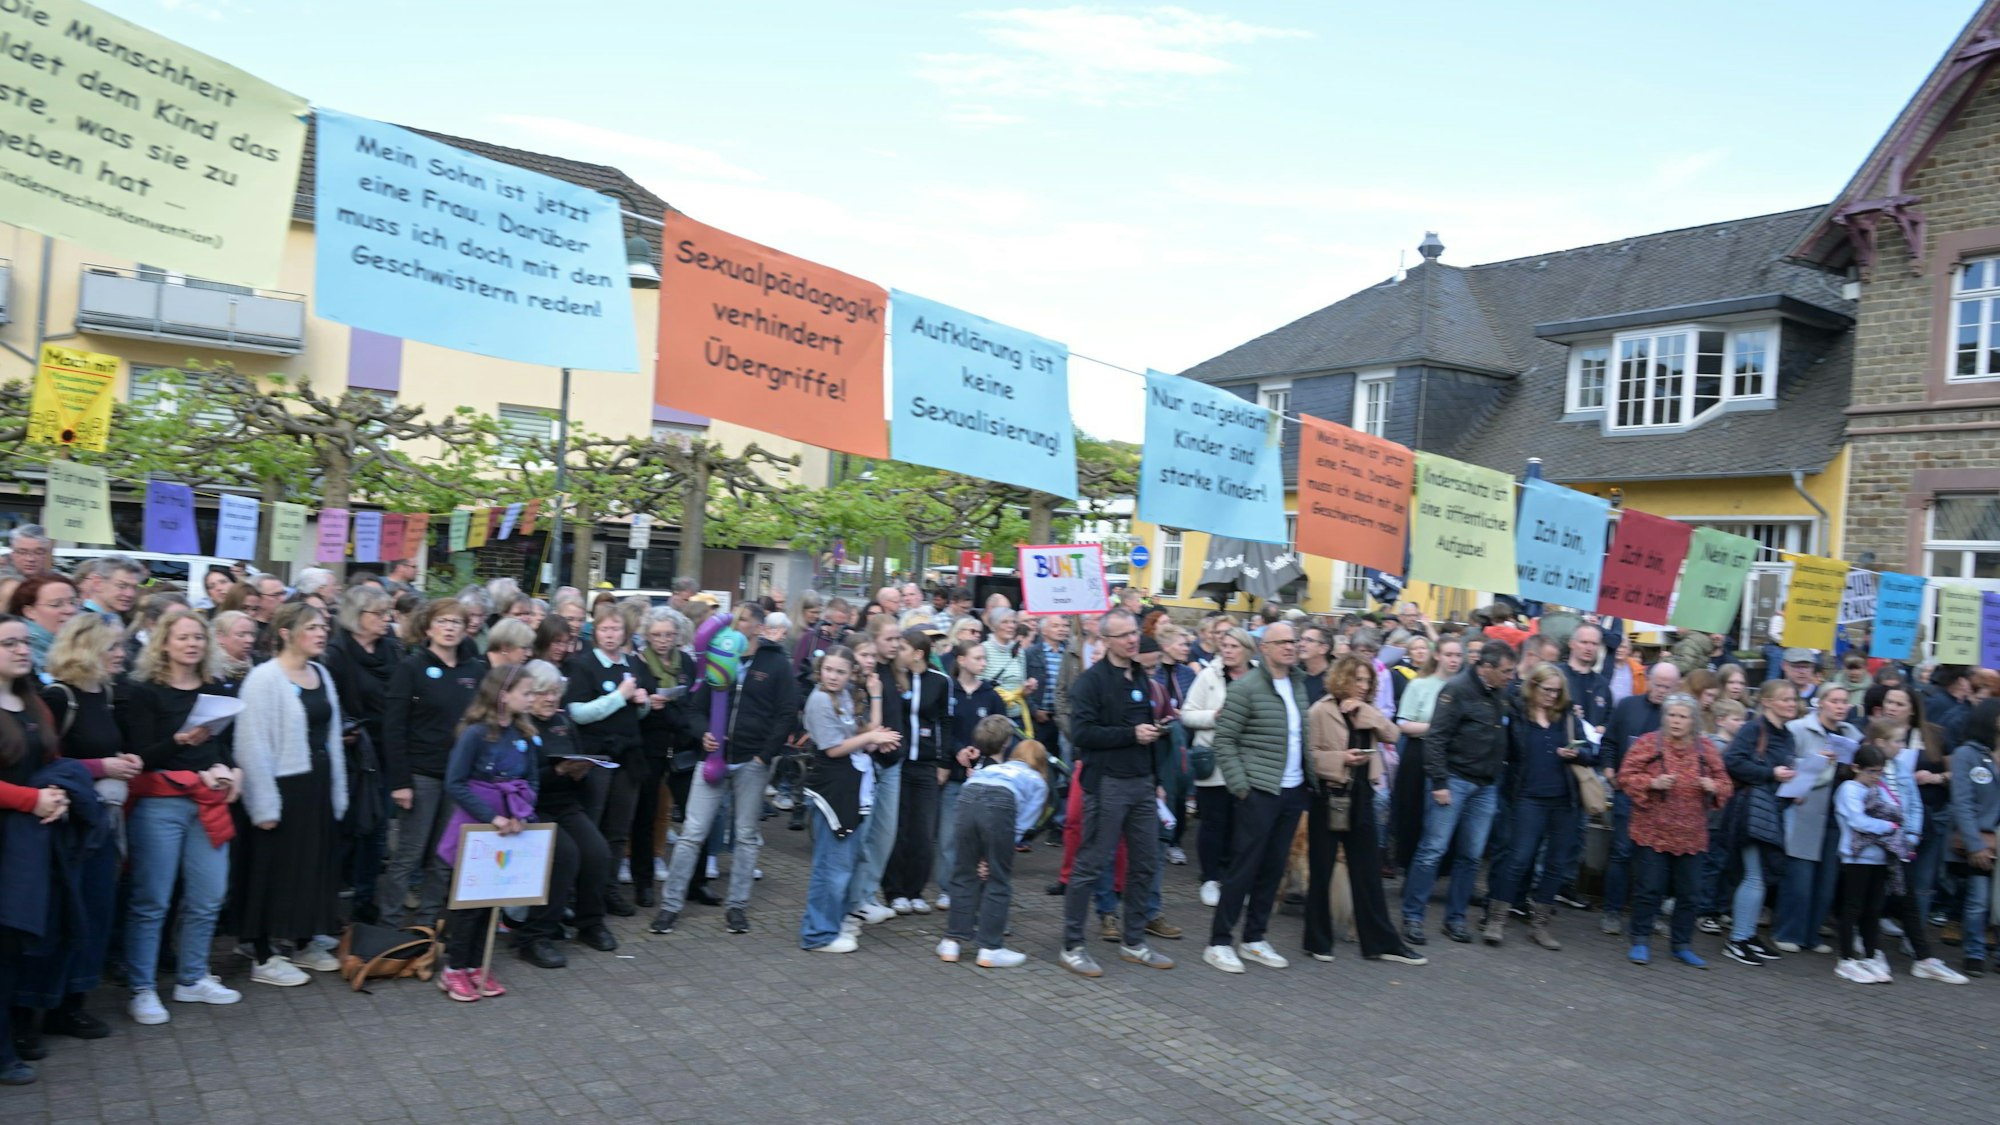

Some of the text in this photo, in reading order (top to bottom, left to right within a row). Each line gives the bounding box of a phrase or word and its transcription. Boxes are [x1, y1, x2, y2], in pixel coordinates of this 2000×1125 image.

[63, 18, 238, 107] Menschheit
[77, 69, 142, 112] dem
[152, 97, 220, 142] Kind
[228, 132, 281, 163] das
[75, 114, 135, 150] was
[146, 143, 190, 171] sie
[203, 163, 238, 187] zu
[97, 160, 153, 197] hat
[356, 134, 591, 224] Mein Sohn ist jetzt
[0, 164, 224, 250] inderrechtskonvention)
[358, 175, 591, 254] eine Frau. Darüber
[336, 206, 613, 289] muss ich doch mit den
[351, 244, 603, 319] Geschwistern reden!
[675, 238, 879, 324] Sexualpädagogik
[712, 300, 844, 356] verhindert
[911, 314, 1054, 375] Aufklärung ist
[704, 336, 847, 402] Übergriffe!
[962, 365, 1016, 401] keine
[1151, 386, 1184, 412] Nur
[910, 396, 1062, 457] Sexualisierung!
[1315, 431, 1340, 447] Mein
[1343, 438, 1366, 454] Sohn
[1173, 428, 1256, 466] Kinder sind
[1316, 457, 1338, 471] eine
[1159, 466, 1270, 503] starke Kinder!
[1307, 479, 1333, 494] muss
[1336, 484, 1350, 498] ich
[1353, 489, 1375, 505] doch
[1492, 484, 1509, 502] ist
[1311, 500, 1376, 528] Geschwistern
[1420, 499, 1508, 532] eine öffentliche
[1435, 534, 1487, 560] Aufgabe!
[1533, 518, 1587, 556] Ich bin,
[1618, 544, 1643, 567] Ich
[1031, 553, 1085, 580] BUNT
[1700, 542, 1748, 570] Nein ist
[1516, 560, 1596, 594] wie ich bin!
[1600, 580, 1668, 610] wie ich bin!
[1701, 582, 1732, 602] nein!
